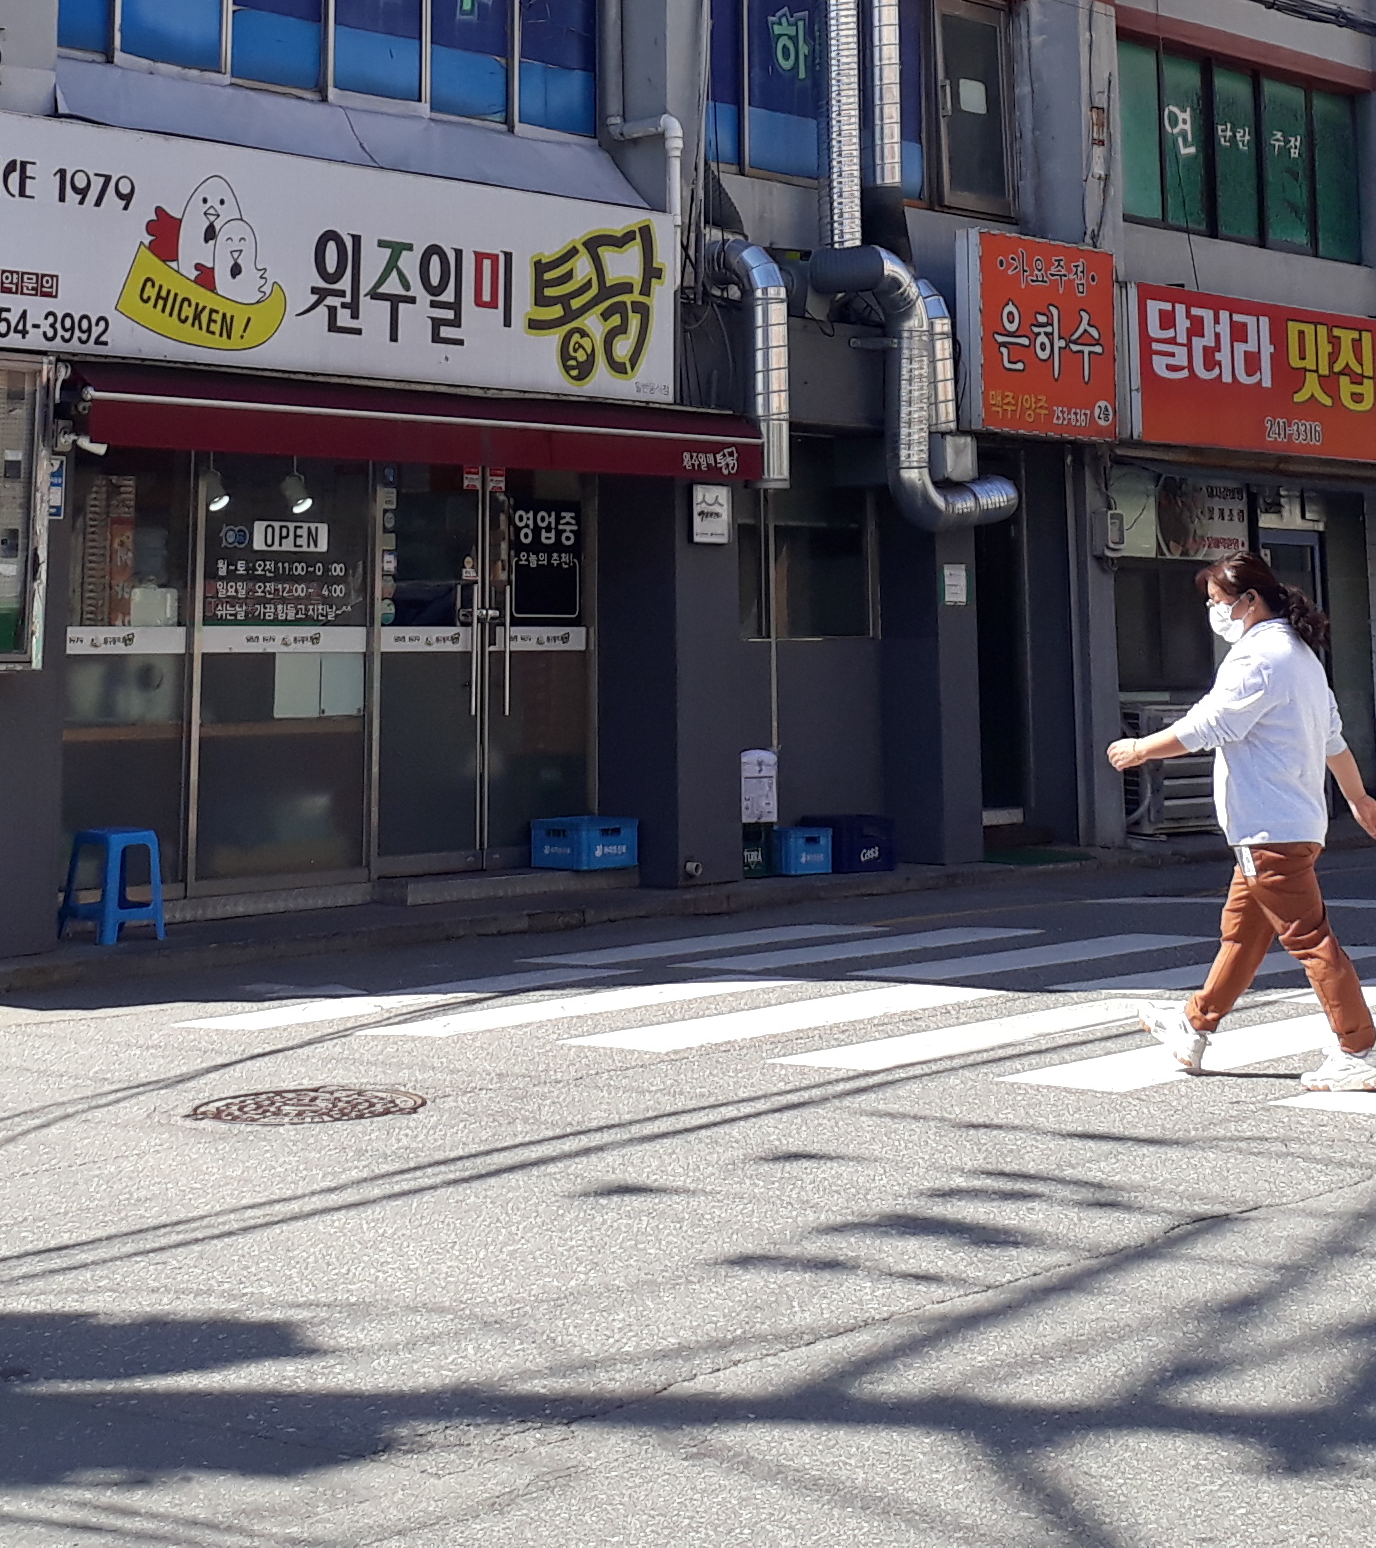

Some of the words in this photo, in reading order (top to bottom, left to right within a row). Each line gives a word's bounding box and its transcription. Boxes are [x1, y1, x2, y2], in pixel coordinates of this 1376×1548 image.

[1164, 104, 1197, 156] 연
[53, 167, 136, 211] 1979
[295, 229, 514, 347] 원주일미
[993, 297, 1104, 385] 은하수
[1146, 299, 1274, 388] 달려라
[1286, 319, 1374, 412] 맛집
[989, 389, 1050, 423] 맥주/양주
[1052, 405, 1091, 427] 253-6367
[1264, 416, 1323, 445] 241-3316
[263, 525, 320, 549] OPEN
[515, 509, 578, 546] 영업중
[518, 552, 548, 567] 오늘의
[550, 553, 573, 567] 추천!
